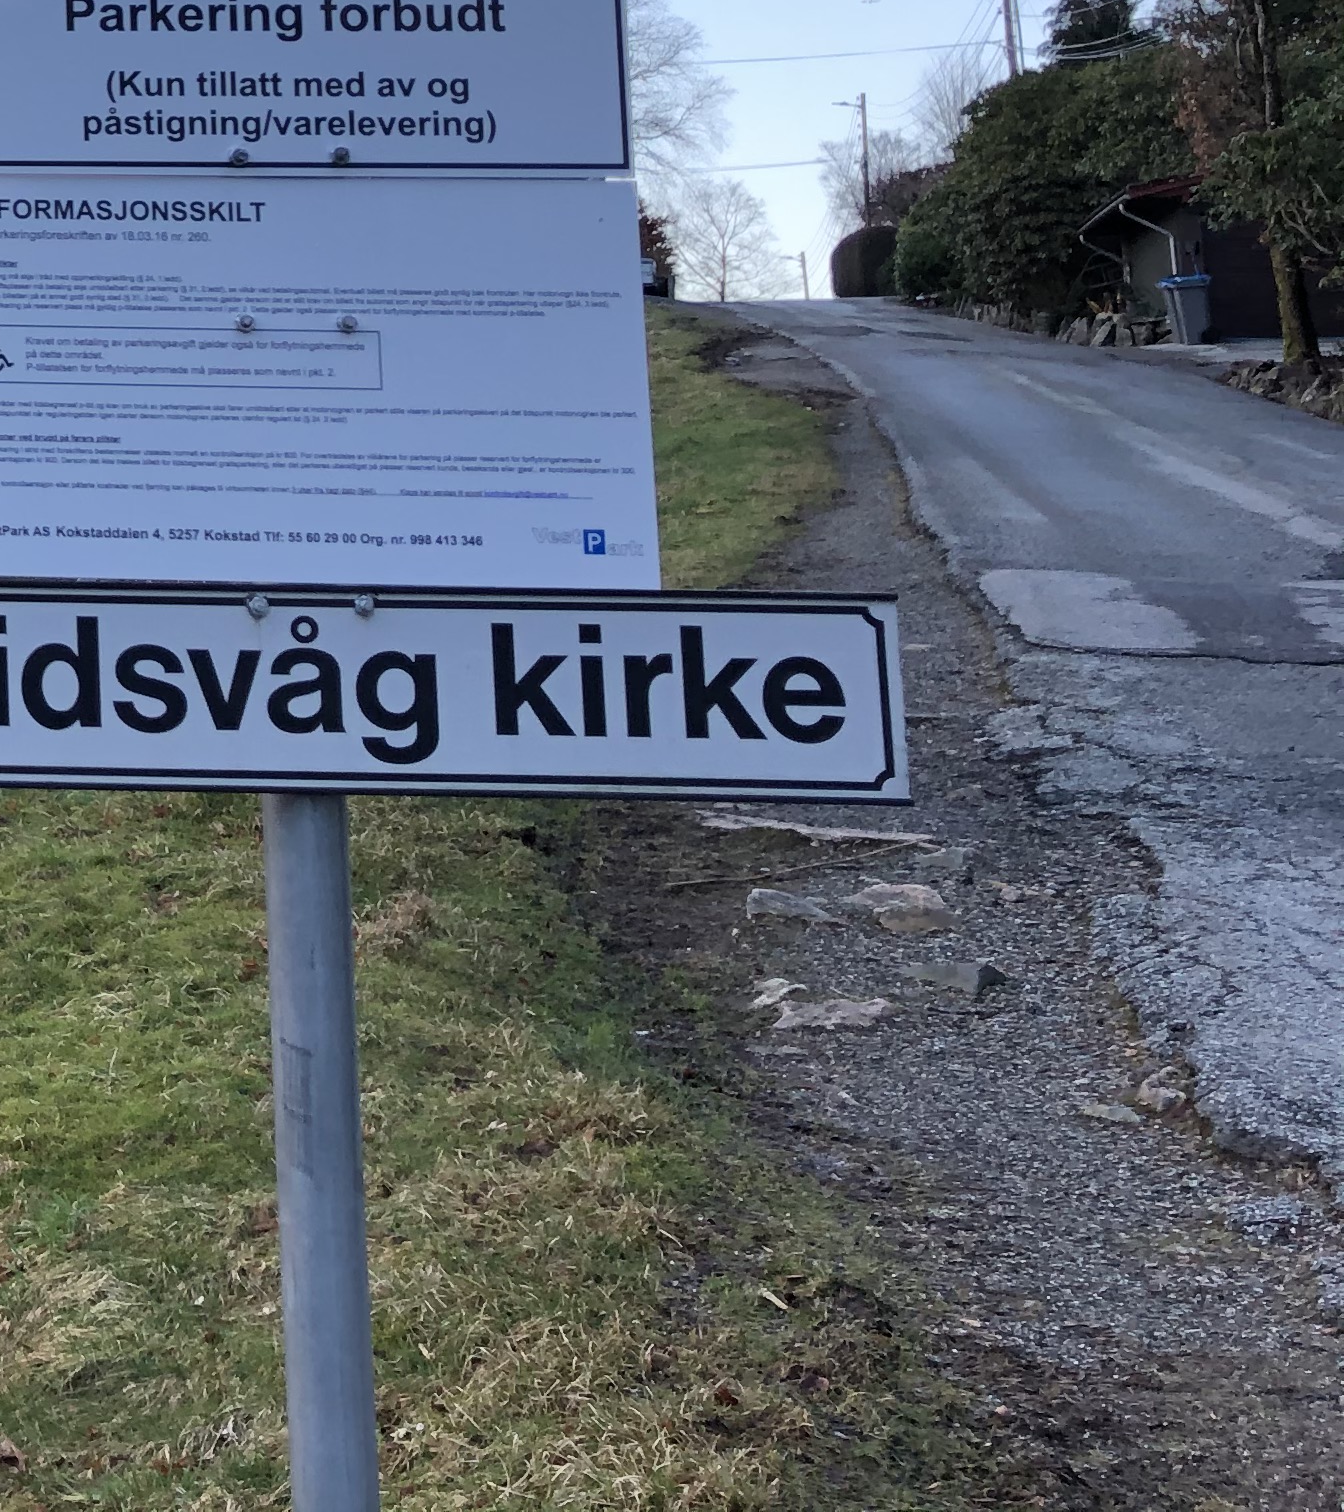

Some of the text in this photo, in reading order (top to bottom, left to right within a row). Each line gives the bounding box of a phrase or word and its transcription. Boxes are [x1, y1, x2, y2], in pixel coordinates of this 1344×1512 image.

[105, 69, 471, 106] (Kun tillatt med av og
[82, 106, 498, 145] påstigning/varelevering)
[32, 526, 51, 538] AS
[55, 525, 149, 539] Kokstaddalen
[152, 528, 165, 541] 4,
[168, 528, 200, 541] 5257
[204, 529, 261, 542] Kokstad
[263, 530, 285, 543] Tlf:
[288, 531, 303, 543] 55
[305, 532, 321, 543] 60
[324, 532, 339, 544] 29
[341, 532, 357, 544] 00
[359, 533, 387, 548] Org.
[390, 536, 407, 545] nr.
[409, 534, 433, 546] 998
[435, 534, 458, 546] 413
[460, 535, 483, 547] 346
[489, 621, 848, 746] kirke
